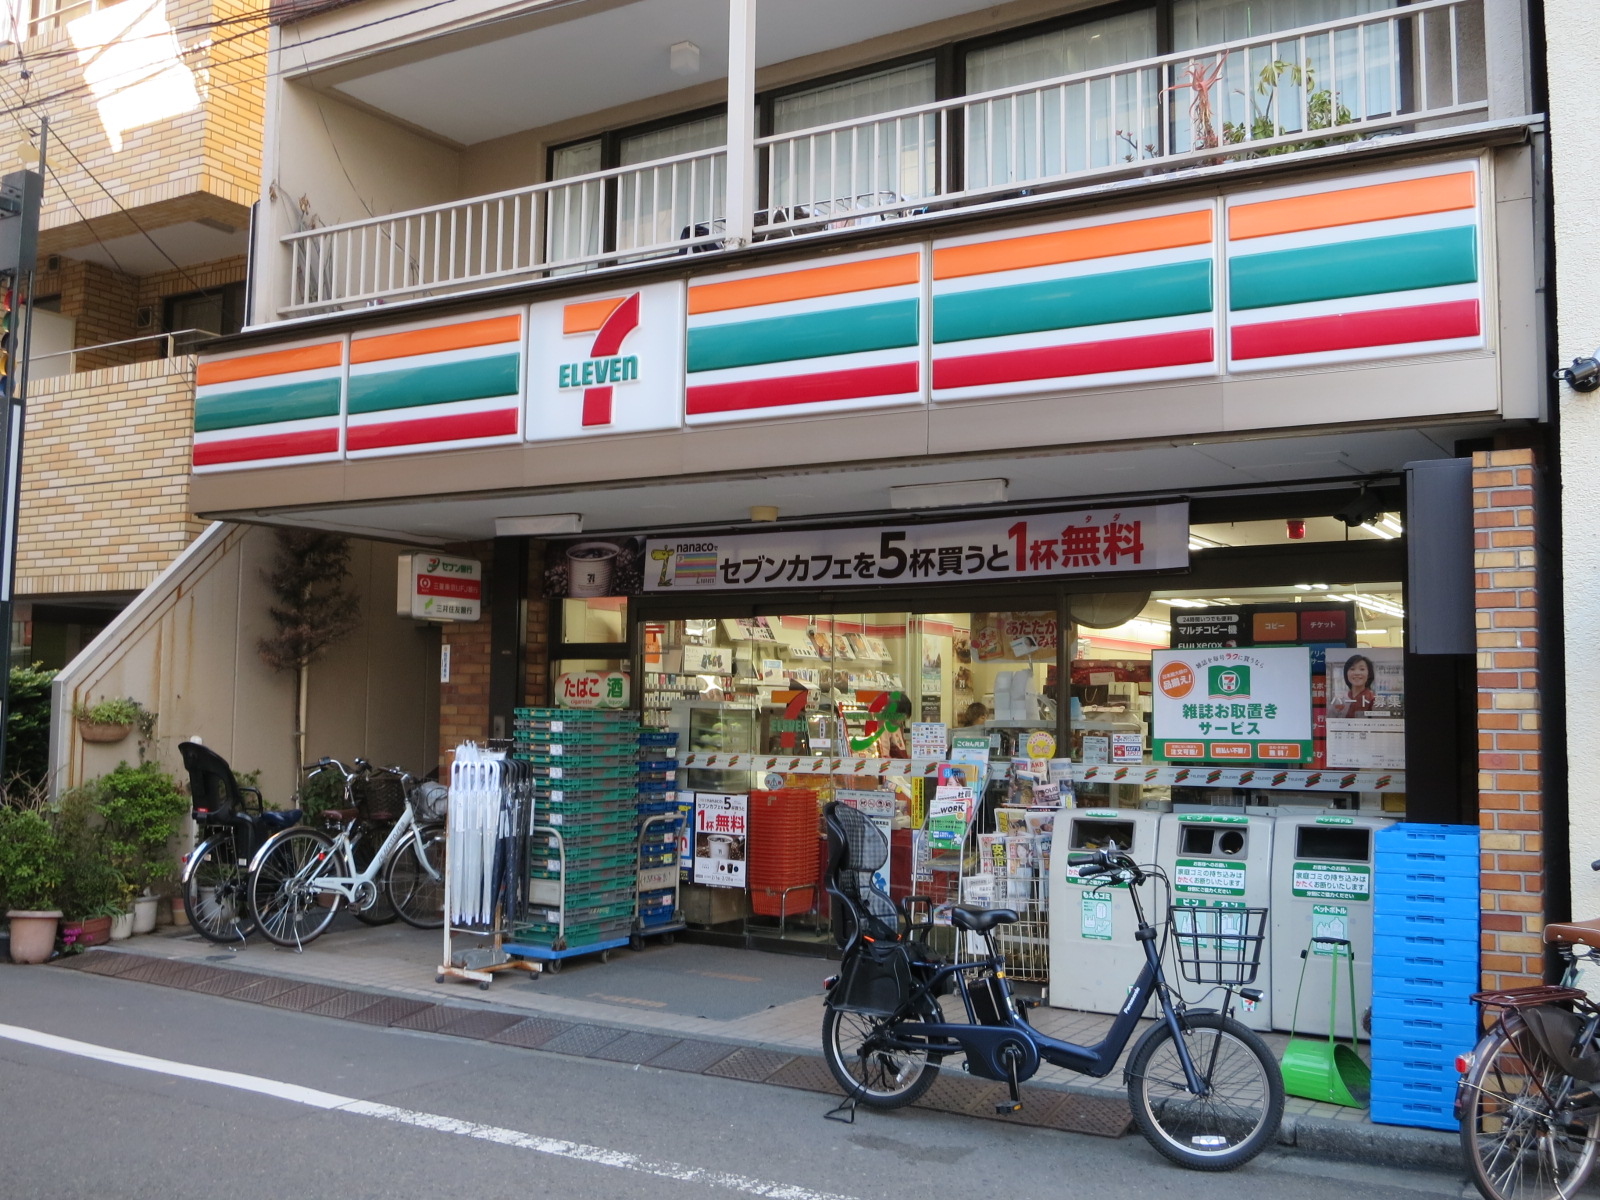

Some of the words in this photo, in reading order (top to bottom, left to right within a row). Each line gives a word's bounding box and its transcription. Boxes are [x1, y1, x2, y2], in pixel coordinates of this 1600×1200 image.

[563, 292, 640, 426] 7
[719, 519, 1145, 586] セブンカフェを5杯買うと1杯無料
[442, 562, 473, 575] セブン銀行
[436, 604, 473, 615] 三井住友銀行
[1178, 625, 1238, 635] マルチコピー機
[1310, 620, 1336, 629] チケット
[564, 677, 600, 698] たばこ
[607, 677, 623, 698] 酒
[1182, 703, 1278, 719] 雑誌お取置き
[1198, 721, 1260, 735] サービス
[940, 805, 965, 814] WORK
[697, 809, 745, 833] 1杯無料
[1177, 868, 1242, 878] 家庭ゴミの持ち込みは
[1295, 872, 1366, 883] 家庭ゴミの持ち込みは
[1295, 880, 1367, 891] かたくお断りいたします。
[1082, 891, 1111, 900] もえるゴミ
[1313, 905, 1347, 914] ペットボトル
[1123, 986, 1141, 1015] Panasonic
